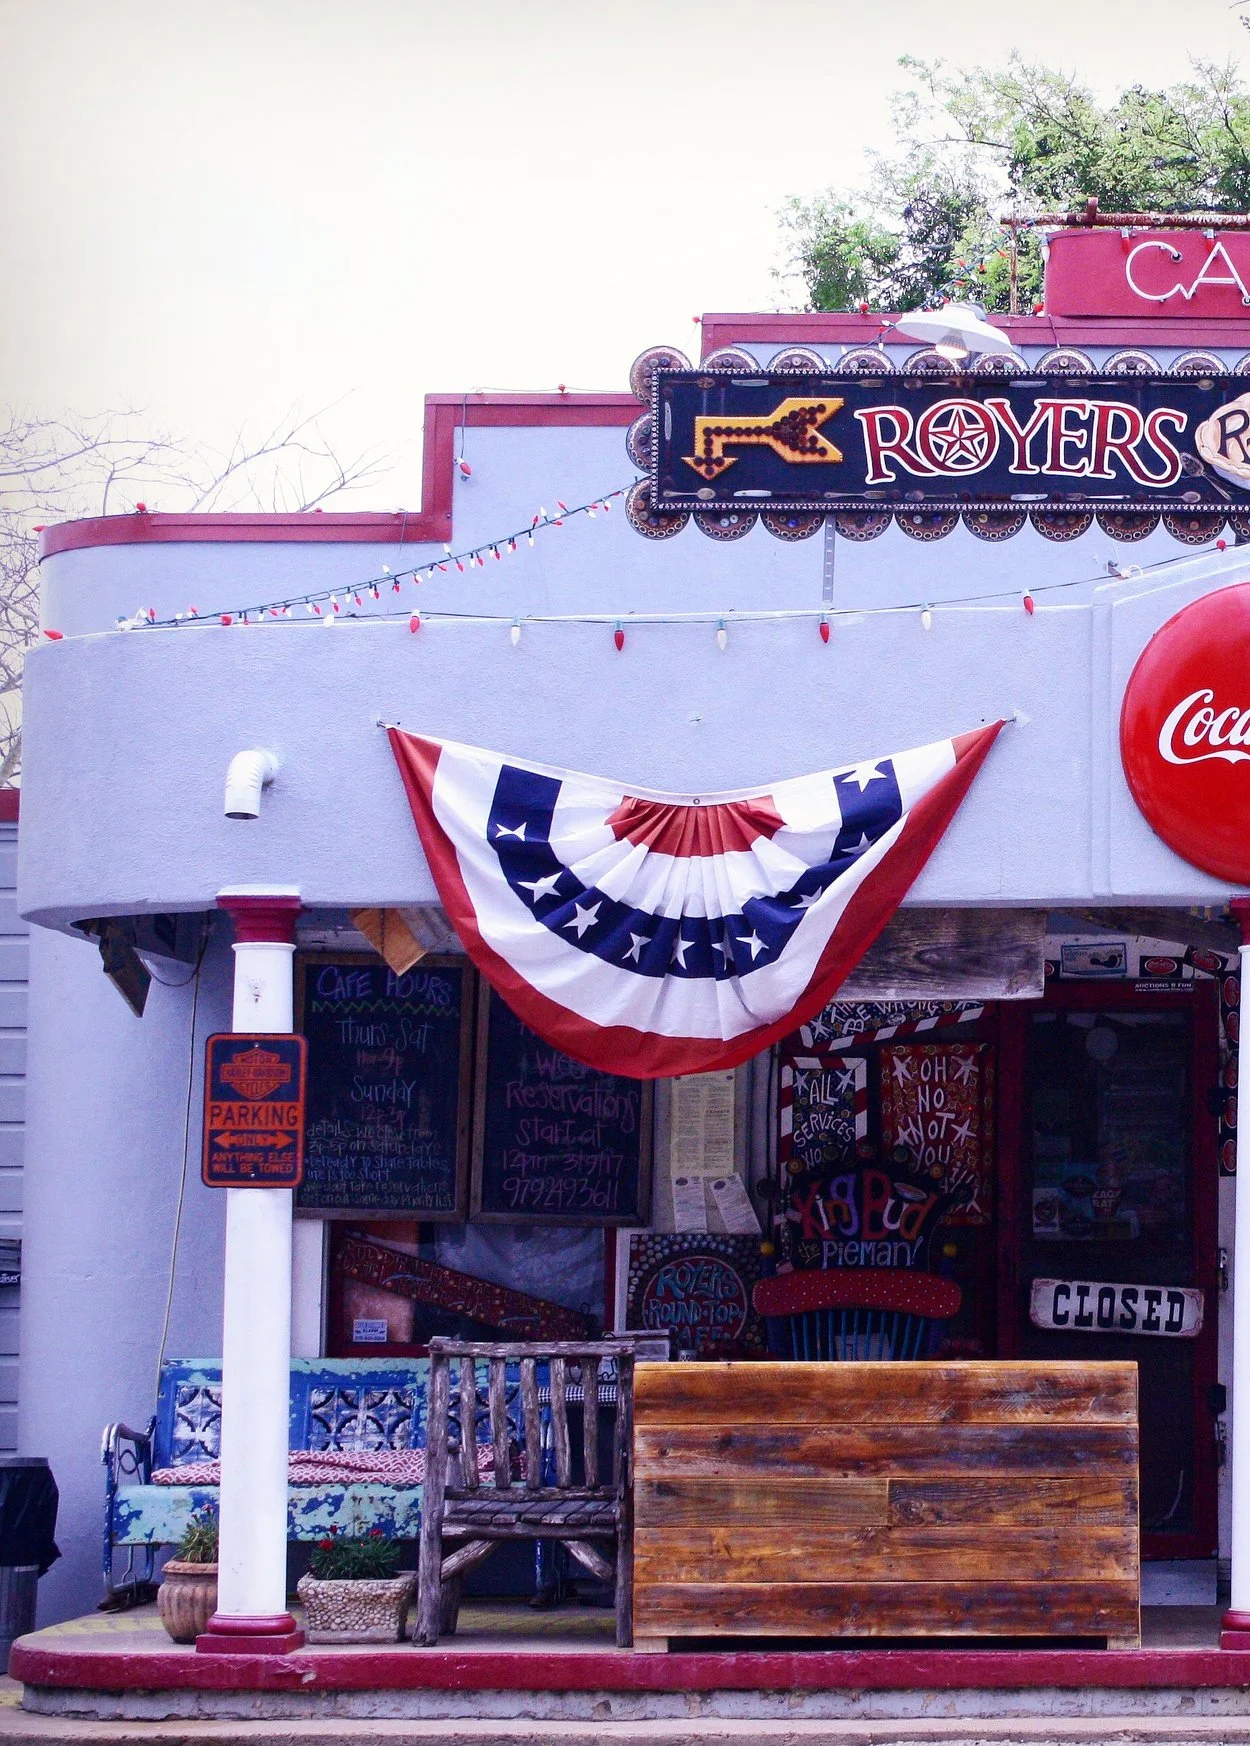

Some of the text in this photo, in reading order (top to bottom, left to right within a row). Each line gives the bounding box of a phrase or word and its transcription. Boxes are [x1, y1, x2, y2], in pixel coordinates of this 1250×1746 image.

[854, 398, 1188, 488] ROYERS
[317, 966, 450, 1003] CAFE HOURS
[842, 1005, 872, 1033] BE
[921, 1056, 947, 1082] OH
[810, 1074, 839, 1105] ALL
[918, 1085, 945, 1113] NO
[210, 1105, 298, 1127] PARKING
[908, 1112, 957, 1145] NOT
[236, 1135, 272, 1146] ONLY
[212, 1152, 294, 1164] ANYTHING ELSE
[212, 1163, 294, 1174] WILL BE TOWED
[910, 1145, 950, 1173] YOU
[656, 1261, 738, 1299] ROYERS
[1052, 1284, 1185, 1333] CLOSED
